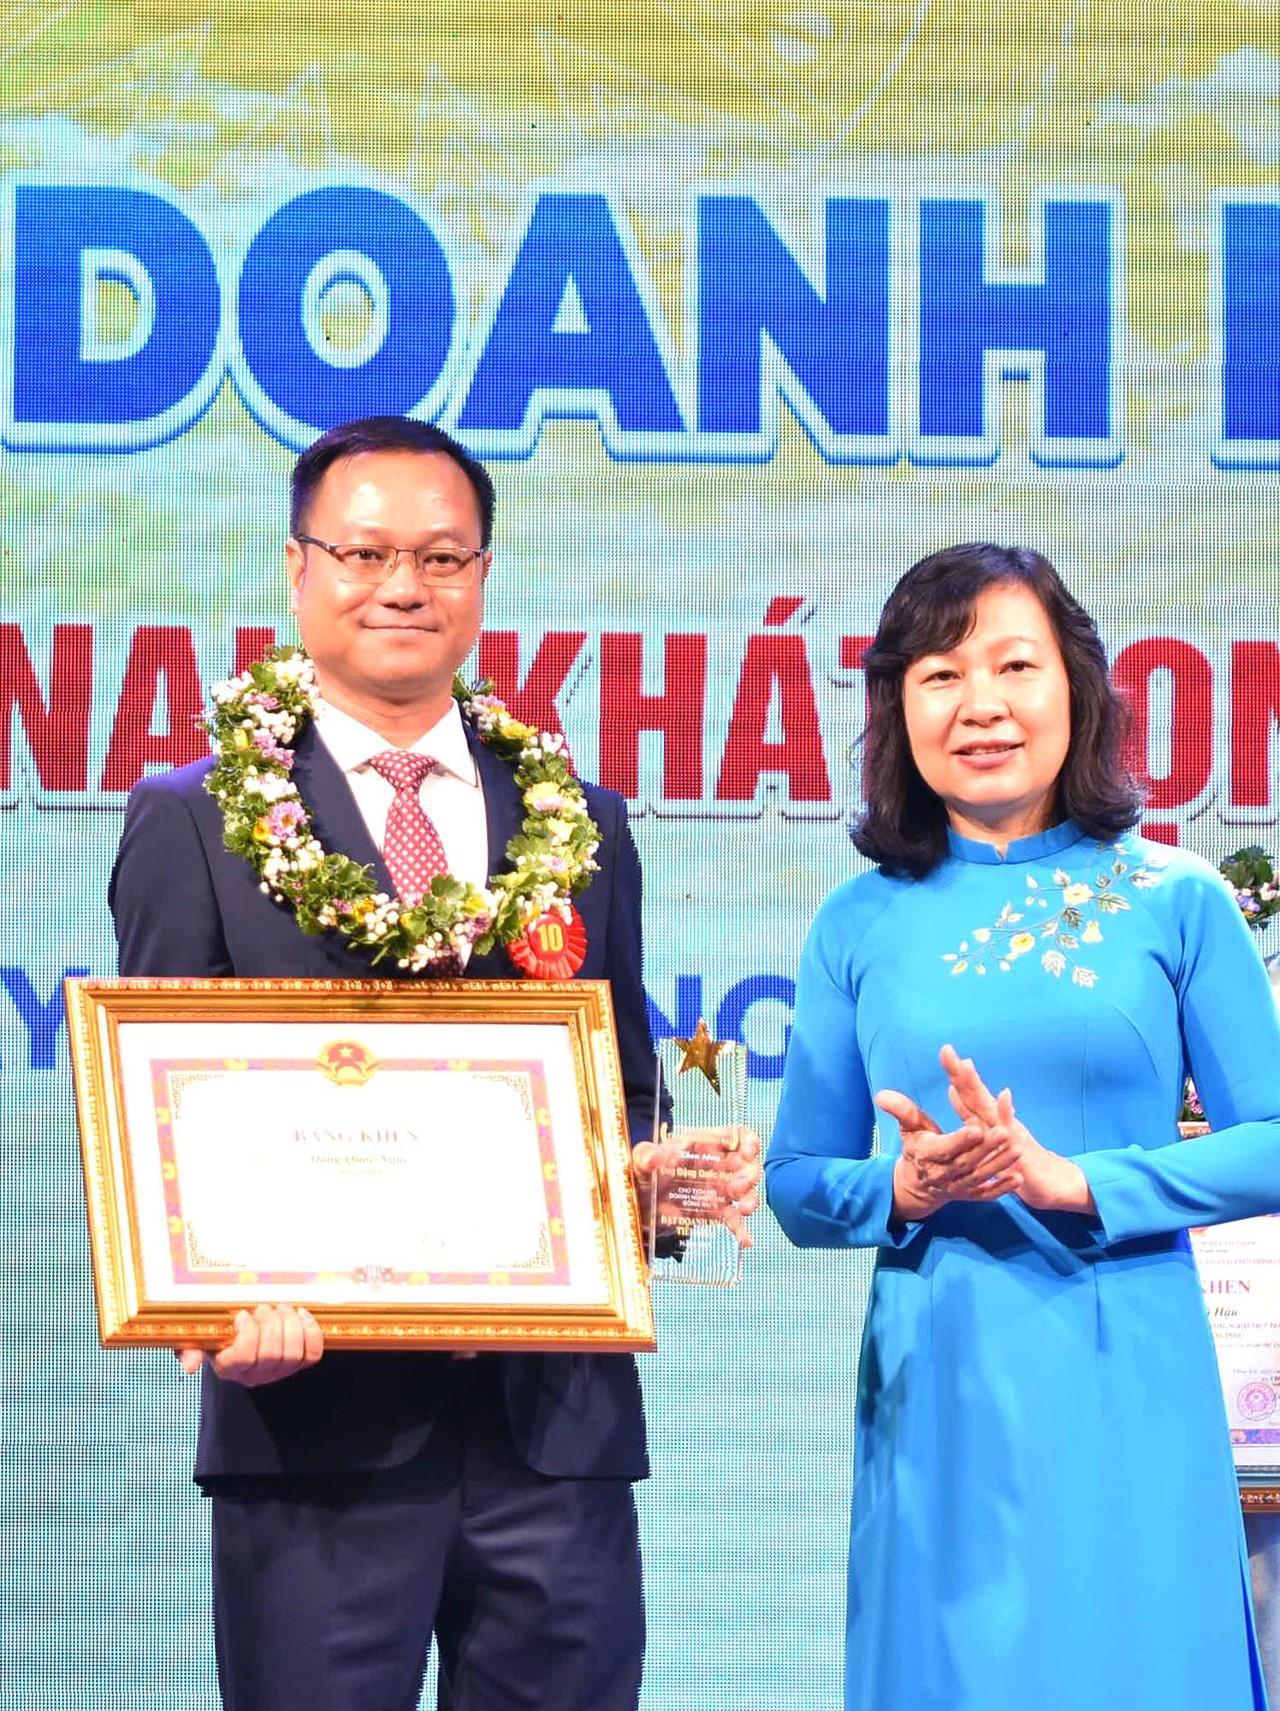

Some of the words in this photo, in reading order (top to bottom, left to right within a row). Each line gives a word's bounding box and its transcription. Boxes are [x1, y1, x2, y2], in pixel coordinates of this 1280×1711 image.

[13, 182, 1113, 442] DOANH
[472, 596, 880, 803] KHÁ
[537, 922, 564, 952] 10
